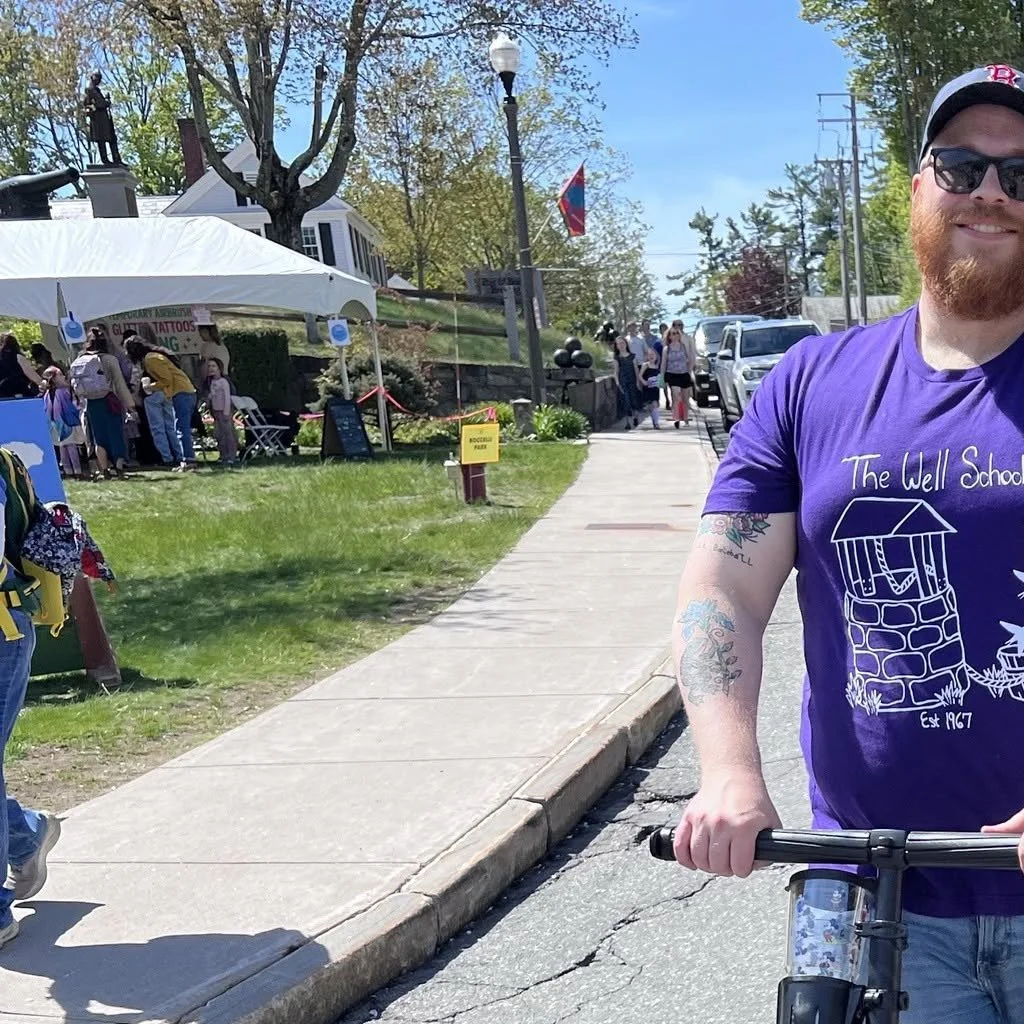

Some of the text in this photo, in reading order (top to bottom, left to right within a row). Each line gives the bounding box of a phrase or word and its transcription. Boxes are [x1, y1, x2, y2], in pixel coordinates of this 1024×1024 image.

[984, 63, 1020, 88] B
[153, 320, 196, 334] TATTOOS
[841, 453, 890, 490] The
[901, 448, 949, 493] Well
[920, 711, 972, 730] Est 1967
